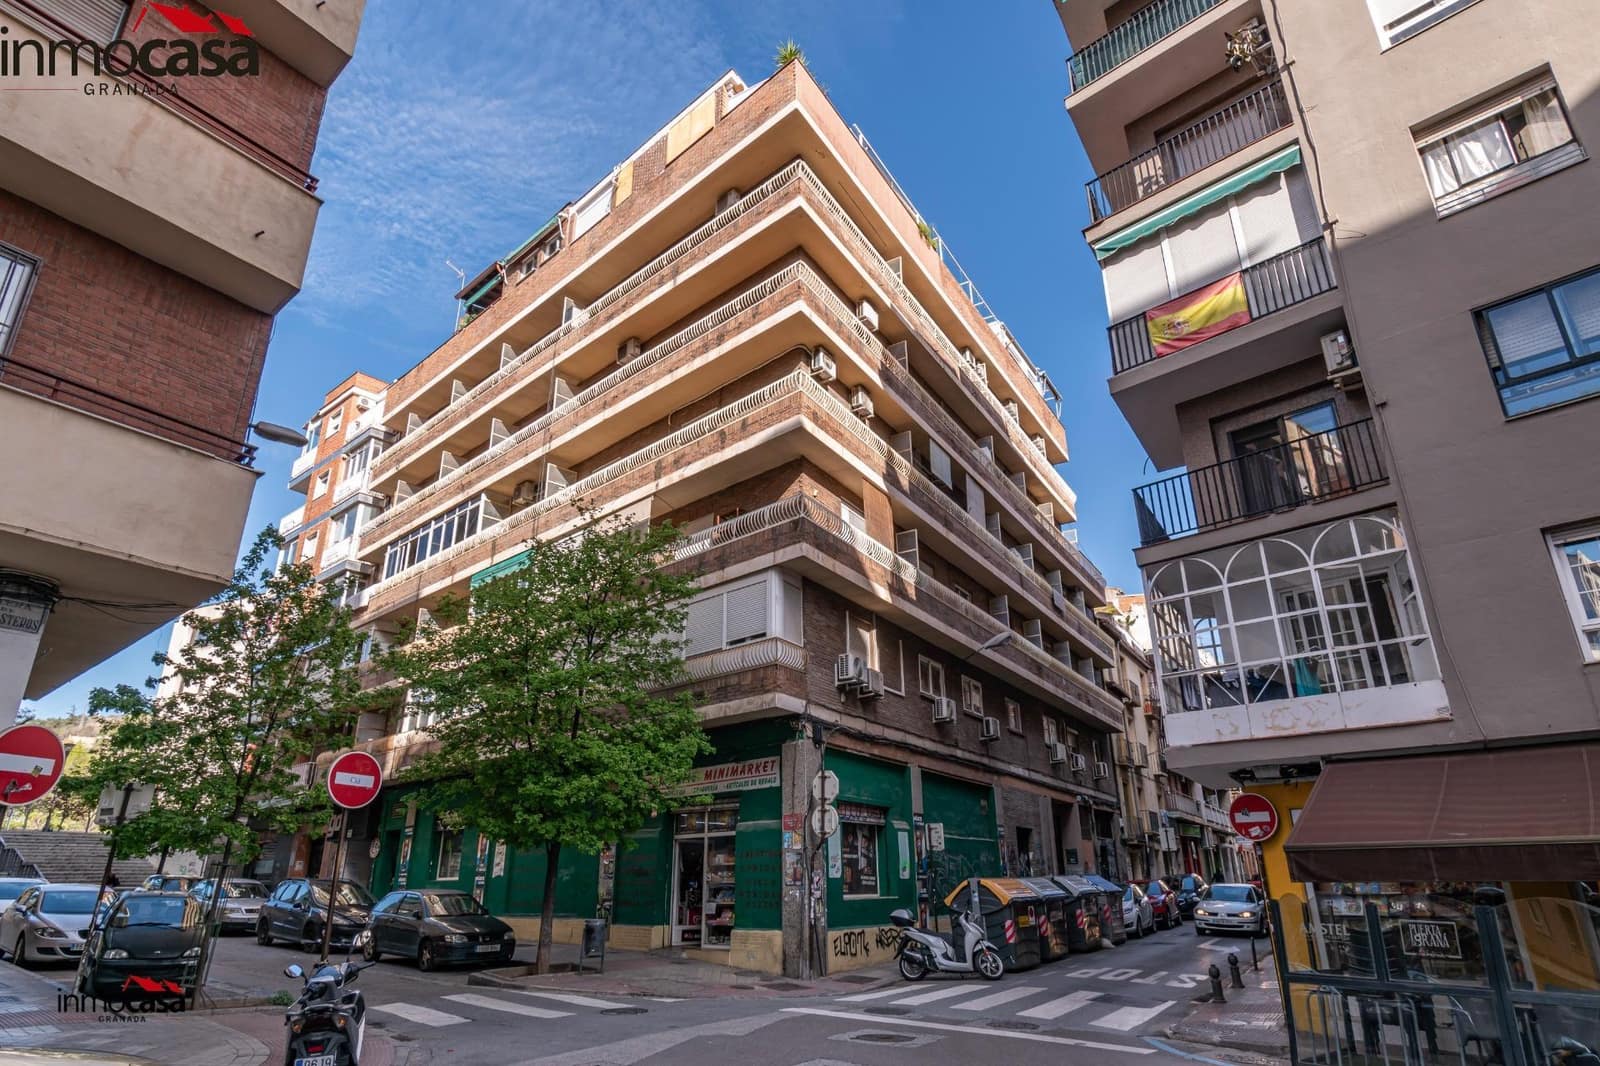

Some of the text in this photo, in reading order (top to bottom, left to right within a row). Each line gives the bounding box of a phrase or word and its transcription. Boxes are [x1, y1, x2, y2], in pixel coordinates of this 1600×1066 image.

[0, 613, 39, 630] STEROS
[704, 760, 776, 781] MINIMARKET
[1408, 924, 1442, 937] PUERTA
[1064, 967, 1210, 989] STOP
